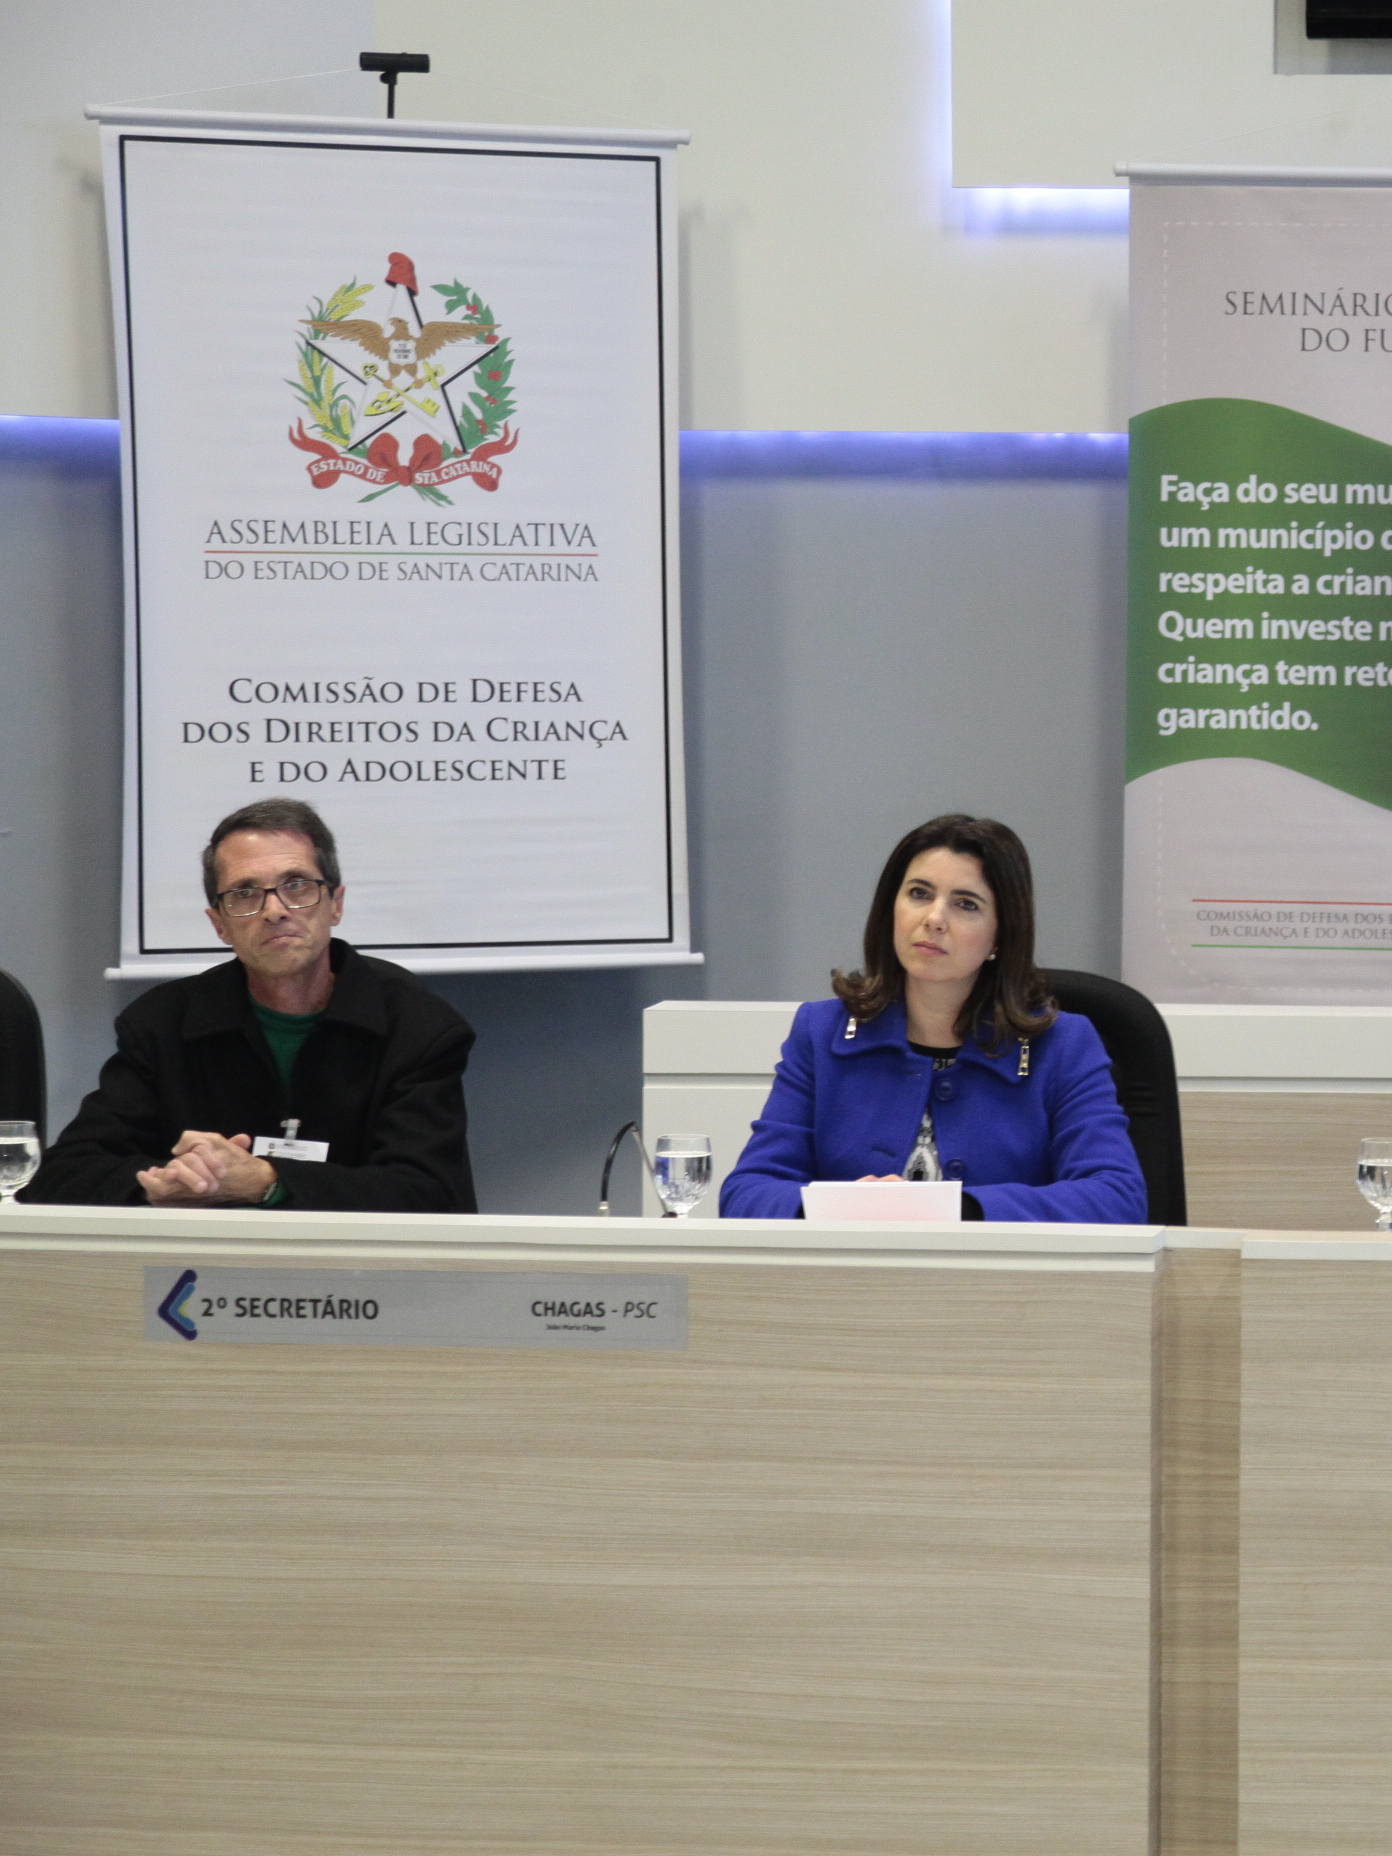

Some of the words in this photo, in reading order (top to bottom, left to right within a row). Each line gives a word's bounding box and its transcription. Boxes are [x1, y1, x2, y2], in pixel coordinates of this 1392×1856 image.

[1300, 327, 1350, 353] DO
[312, 461, 365, 475] ESTADO
[367, 469, 386, 482] DE
[442, 461, 498, 478] CATARINA
[1160, 475, 1230, 511] Faça
[1237, 474, 1278, 504] do
[1284, 482, 1338, 504] seu
[205, 520, 398, 546] ASSEMBLEIA
[408, 522, 598, 548] LEGISLATIVA
[1160, 526, 1211, 548] um
[1218, 522, 1375, 557] município
[204, 561, 244, 580] DO
[253, 561, 349, 581] ESTADO
[357, 561, 390, 581] DE
[397, 562, 475, 582] SANTA
[480, 562, 598, 583] CATARINA
[1159, 567, 1285, 601] respeita
[1291, 574, 1310, 595] a
[1158, 611, 1254, 643] Quem
[1261, 612, 1373, 641] investe
[1157, 656, 1269, 693] criança
[1276, 660, 1337, 687] tem
[1157, 702, 1319, 736] garantido.
[250, 761, 264, 783] E
[1197, 910, 1272, 922] COMISSÃO
[1277, 912, 1295, 923] DE
[1299, 912, 1349, 924] DEFESA
[1354, 913, 1384, 924] DOS
[1210, 925, 1230, 936] DA
[1234, 926, 1299, 940] CRIANÇA
[1303, 927, 1309, 938] E
[1315, 927, 1338, 938] DO
[235, 1294, 380, 1321] SECRETÁRIO
[532, 1300, 605, 1317] CHAGAS
[623, 1301, 658, 1319] PSC
